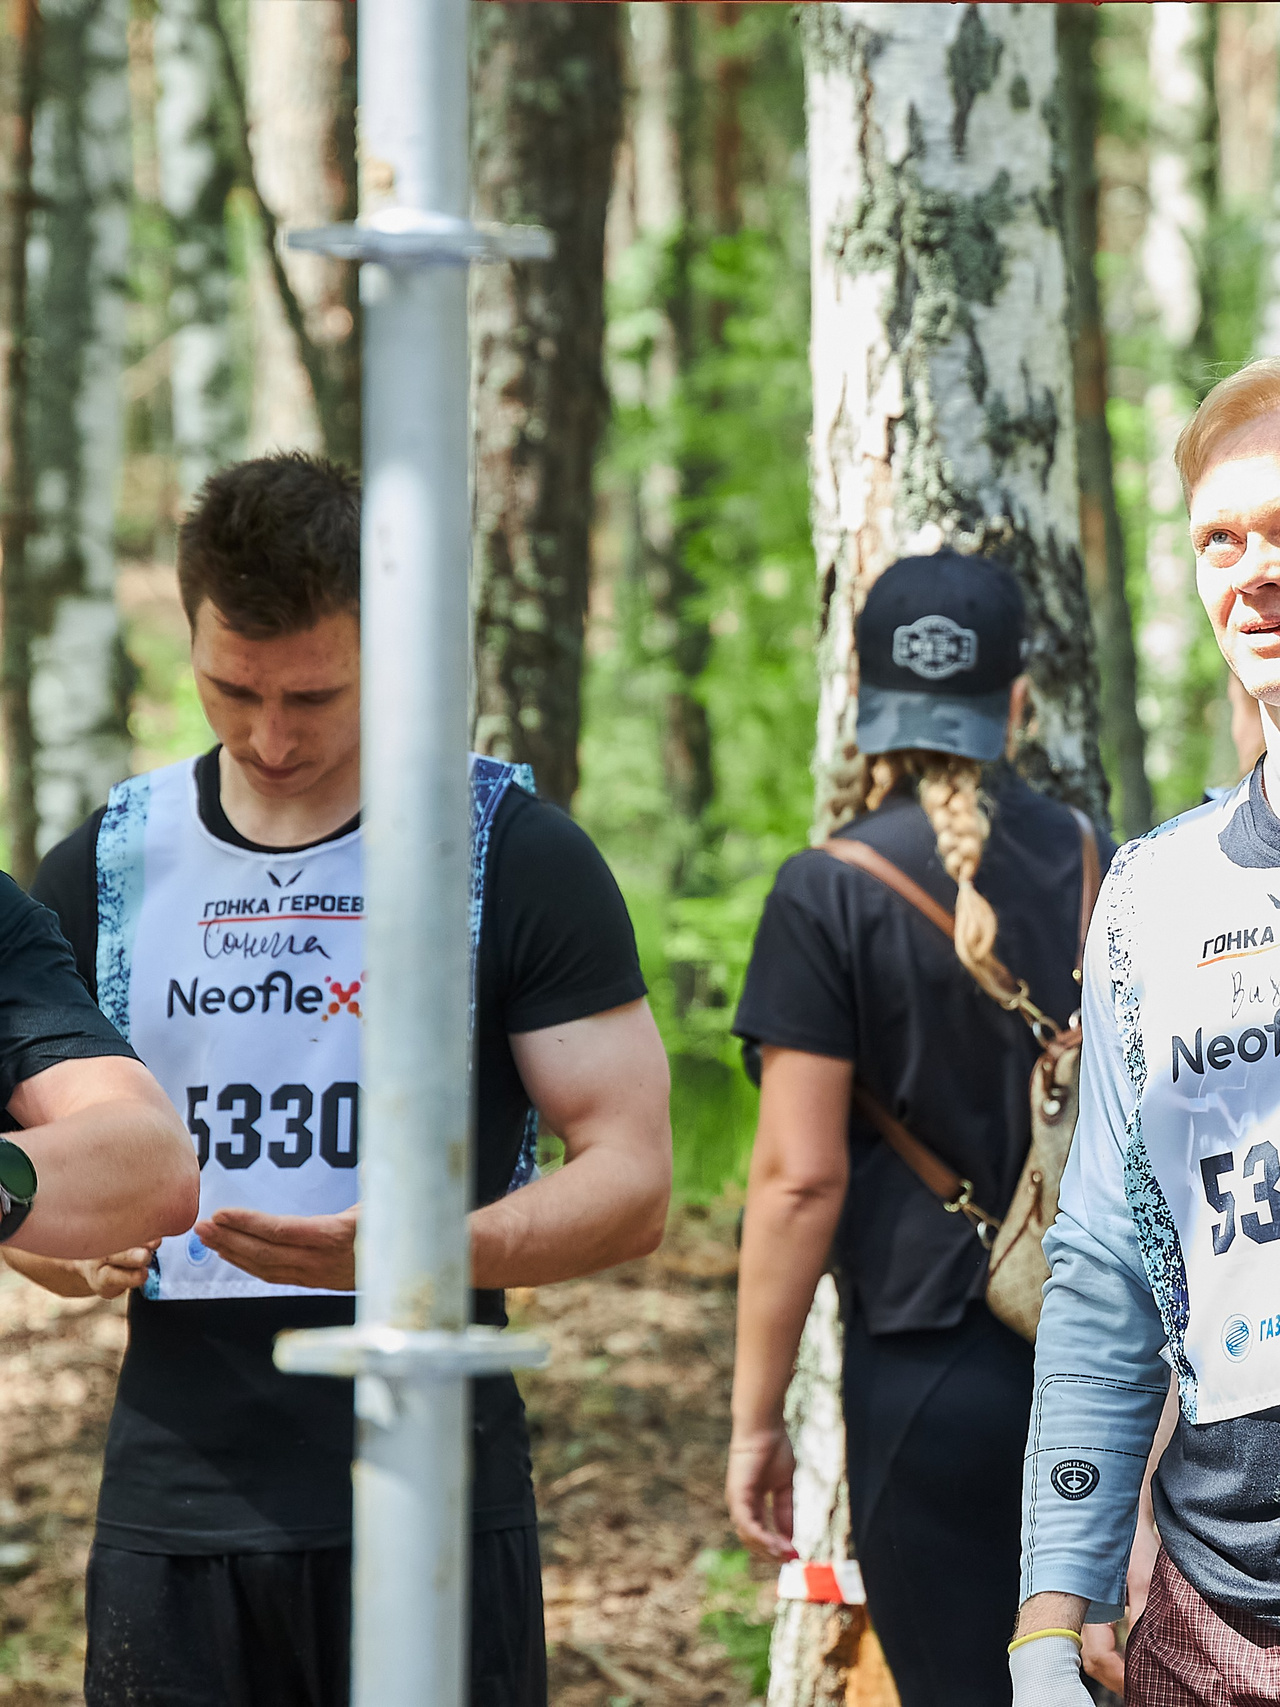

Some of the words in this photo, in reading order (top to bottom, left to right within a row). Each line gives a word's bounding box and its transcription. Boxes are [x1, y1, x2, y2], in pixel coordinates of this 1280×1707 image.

[203, 897, 270, 918] ГОНКА
[278, 894, 365, 913] ГЕРОЕВ
[1202, 925, 1275, 959] ГОНКА
[167, 970, 369, 1021] Neoflex
[186, 1082, 358, 1172] 5330
